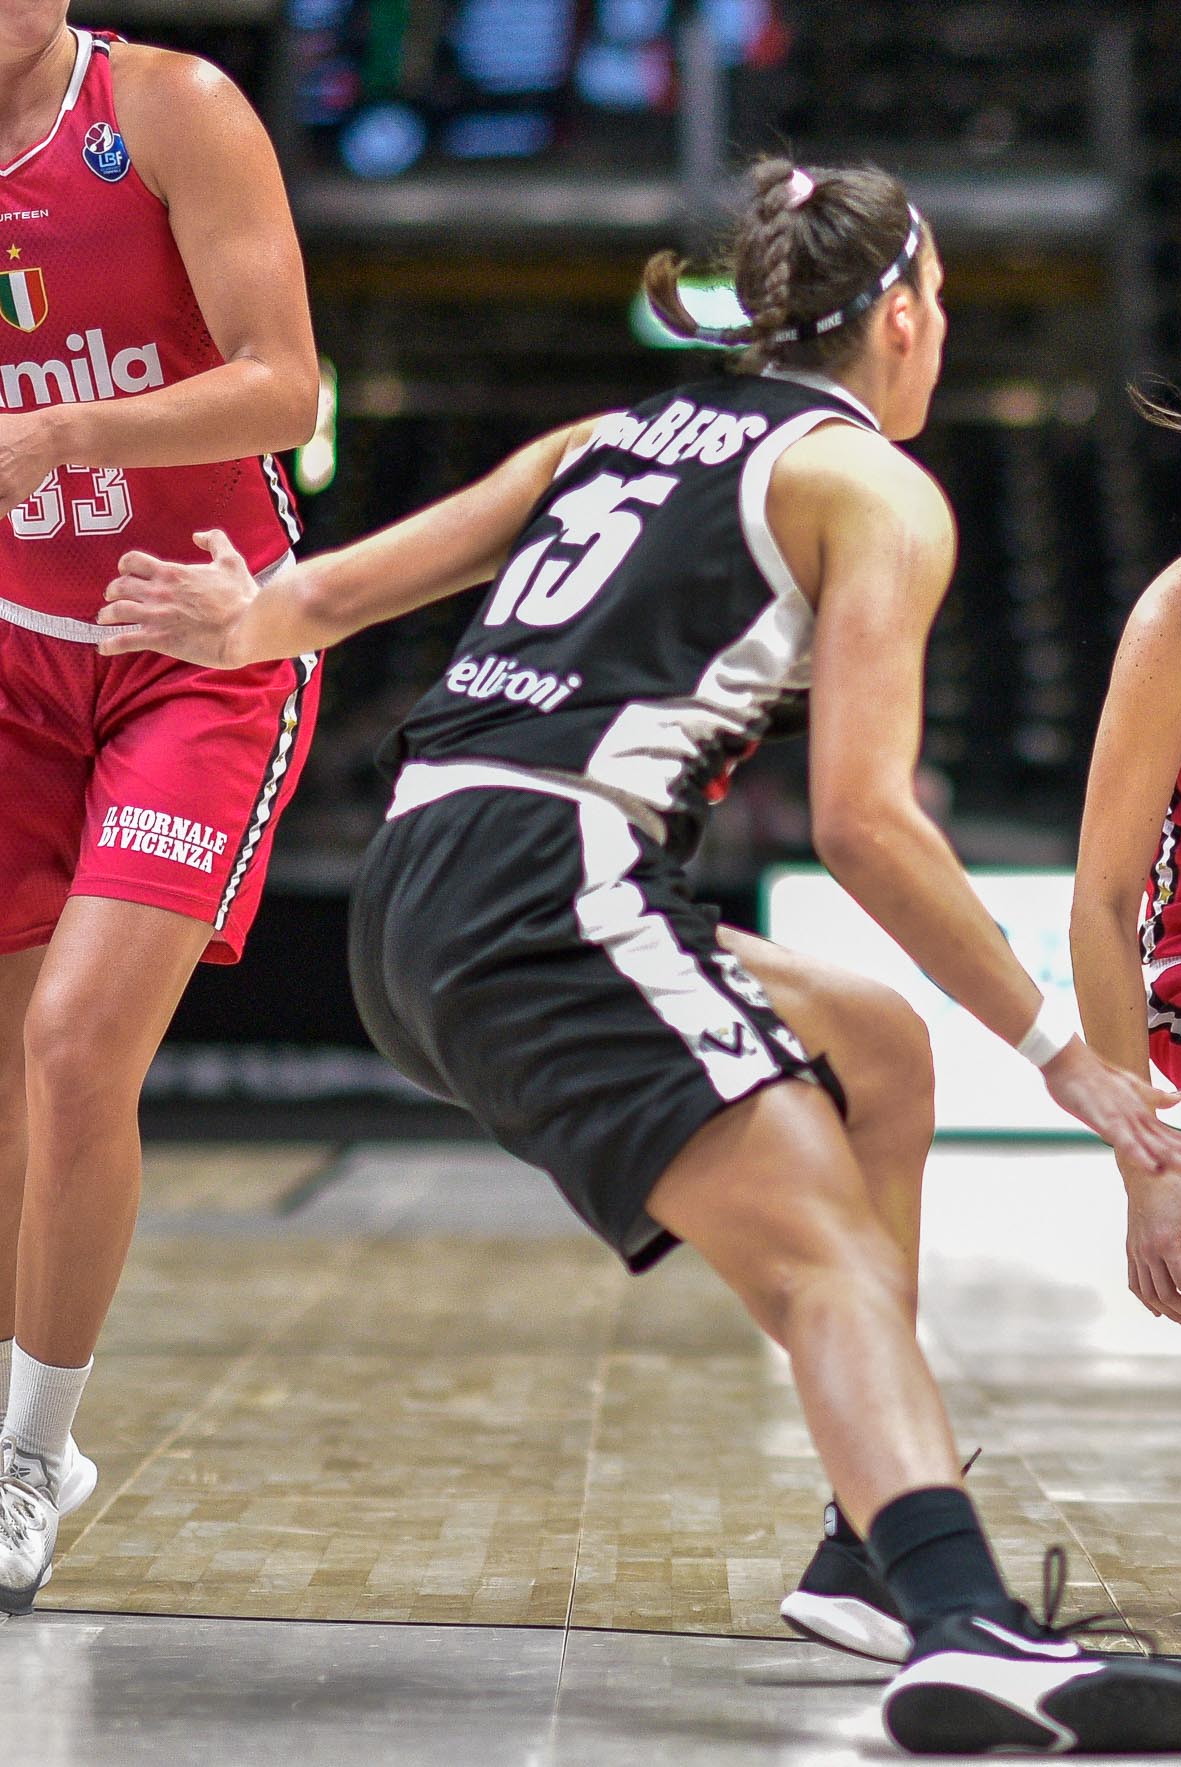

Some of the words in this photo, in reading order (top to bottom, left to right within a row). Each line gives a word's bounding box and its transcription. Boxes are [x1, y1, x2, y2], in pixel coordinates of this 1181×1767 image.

[816, 311, 842, 334] NIKE
[0, 328, 164, 408] mila
[8, 464, 133, 540] 33
[484, 473, 681, 626] 15
[97, 827, 120, 847] DI
[120, 827, 214, 874] VICENZA
[102, 806, 119, 827] IL
[119, 805, 228, 855] GIORNALE
